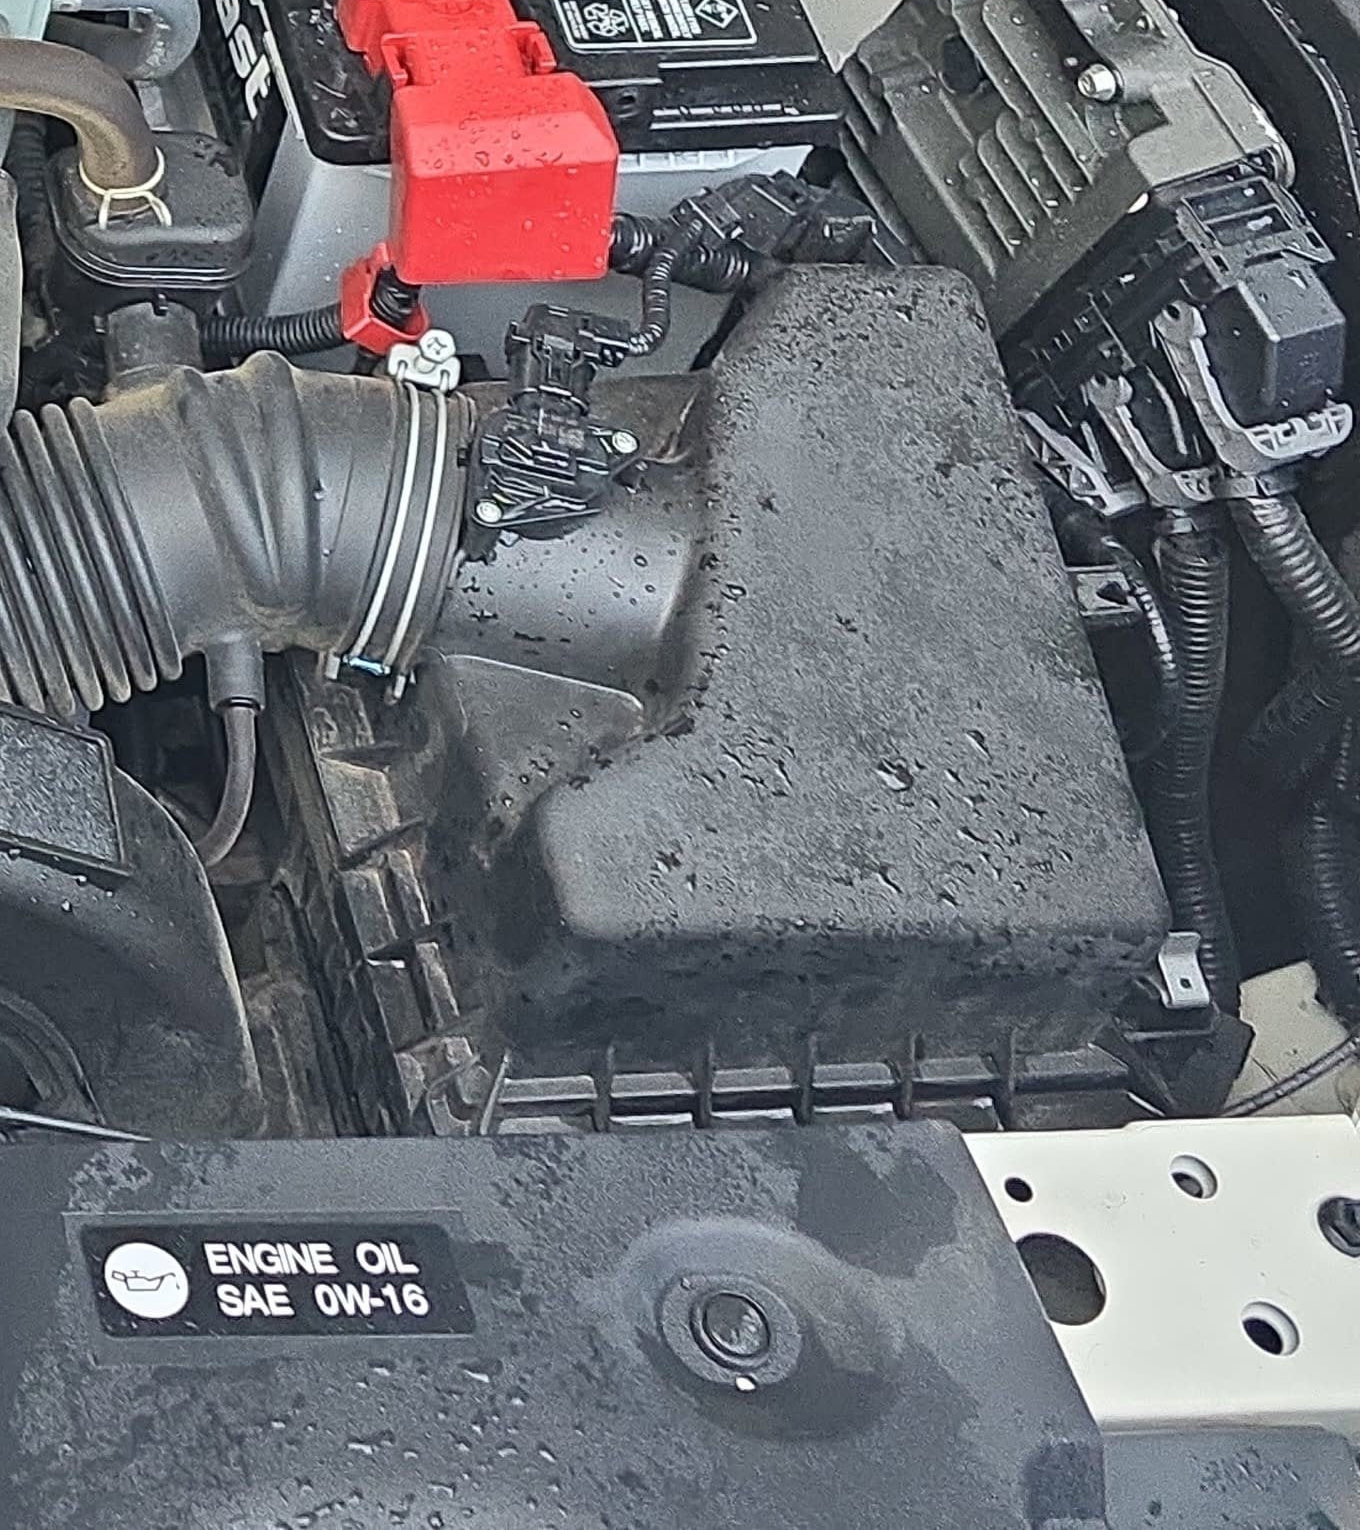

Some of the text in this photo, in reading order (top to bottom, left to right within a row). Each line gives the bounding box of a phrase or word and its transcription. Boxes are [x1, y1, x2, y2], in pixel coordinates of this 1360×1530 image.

[203, 1242, 420, 1275] ENGINE OIL
[217, 1283, 429, 1317] SAE 0W-16
